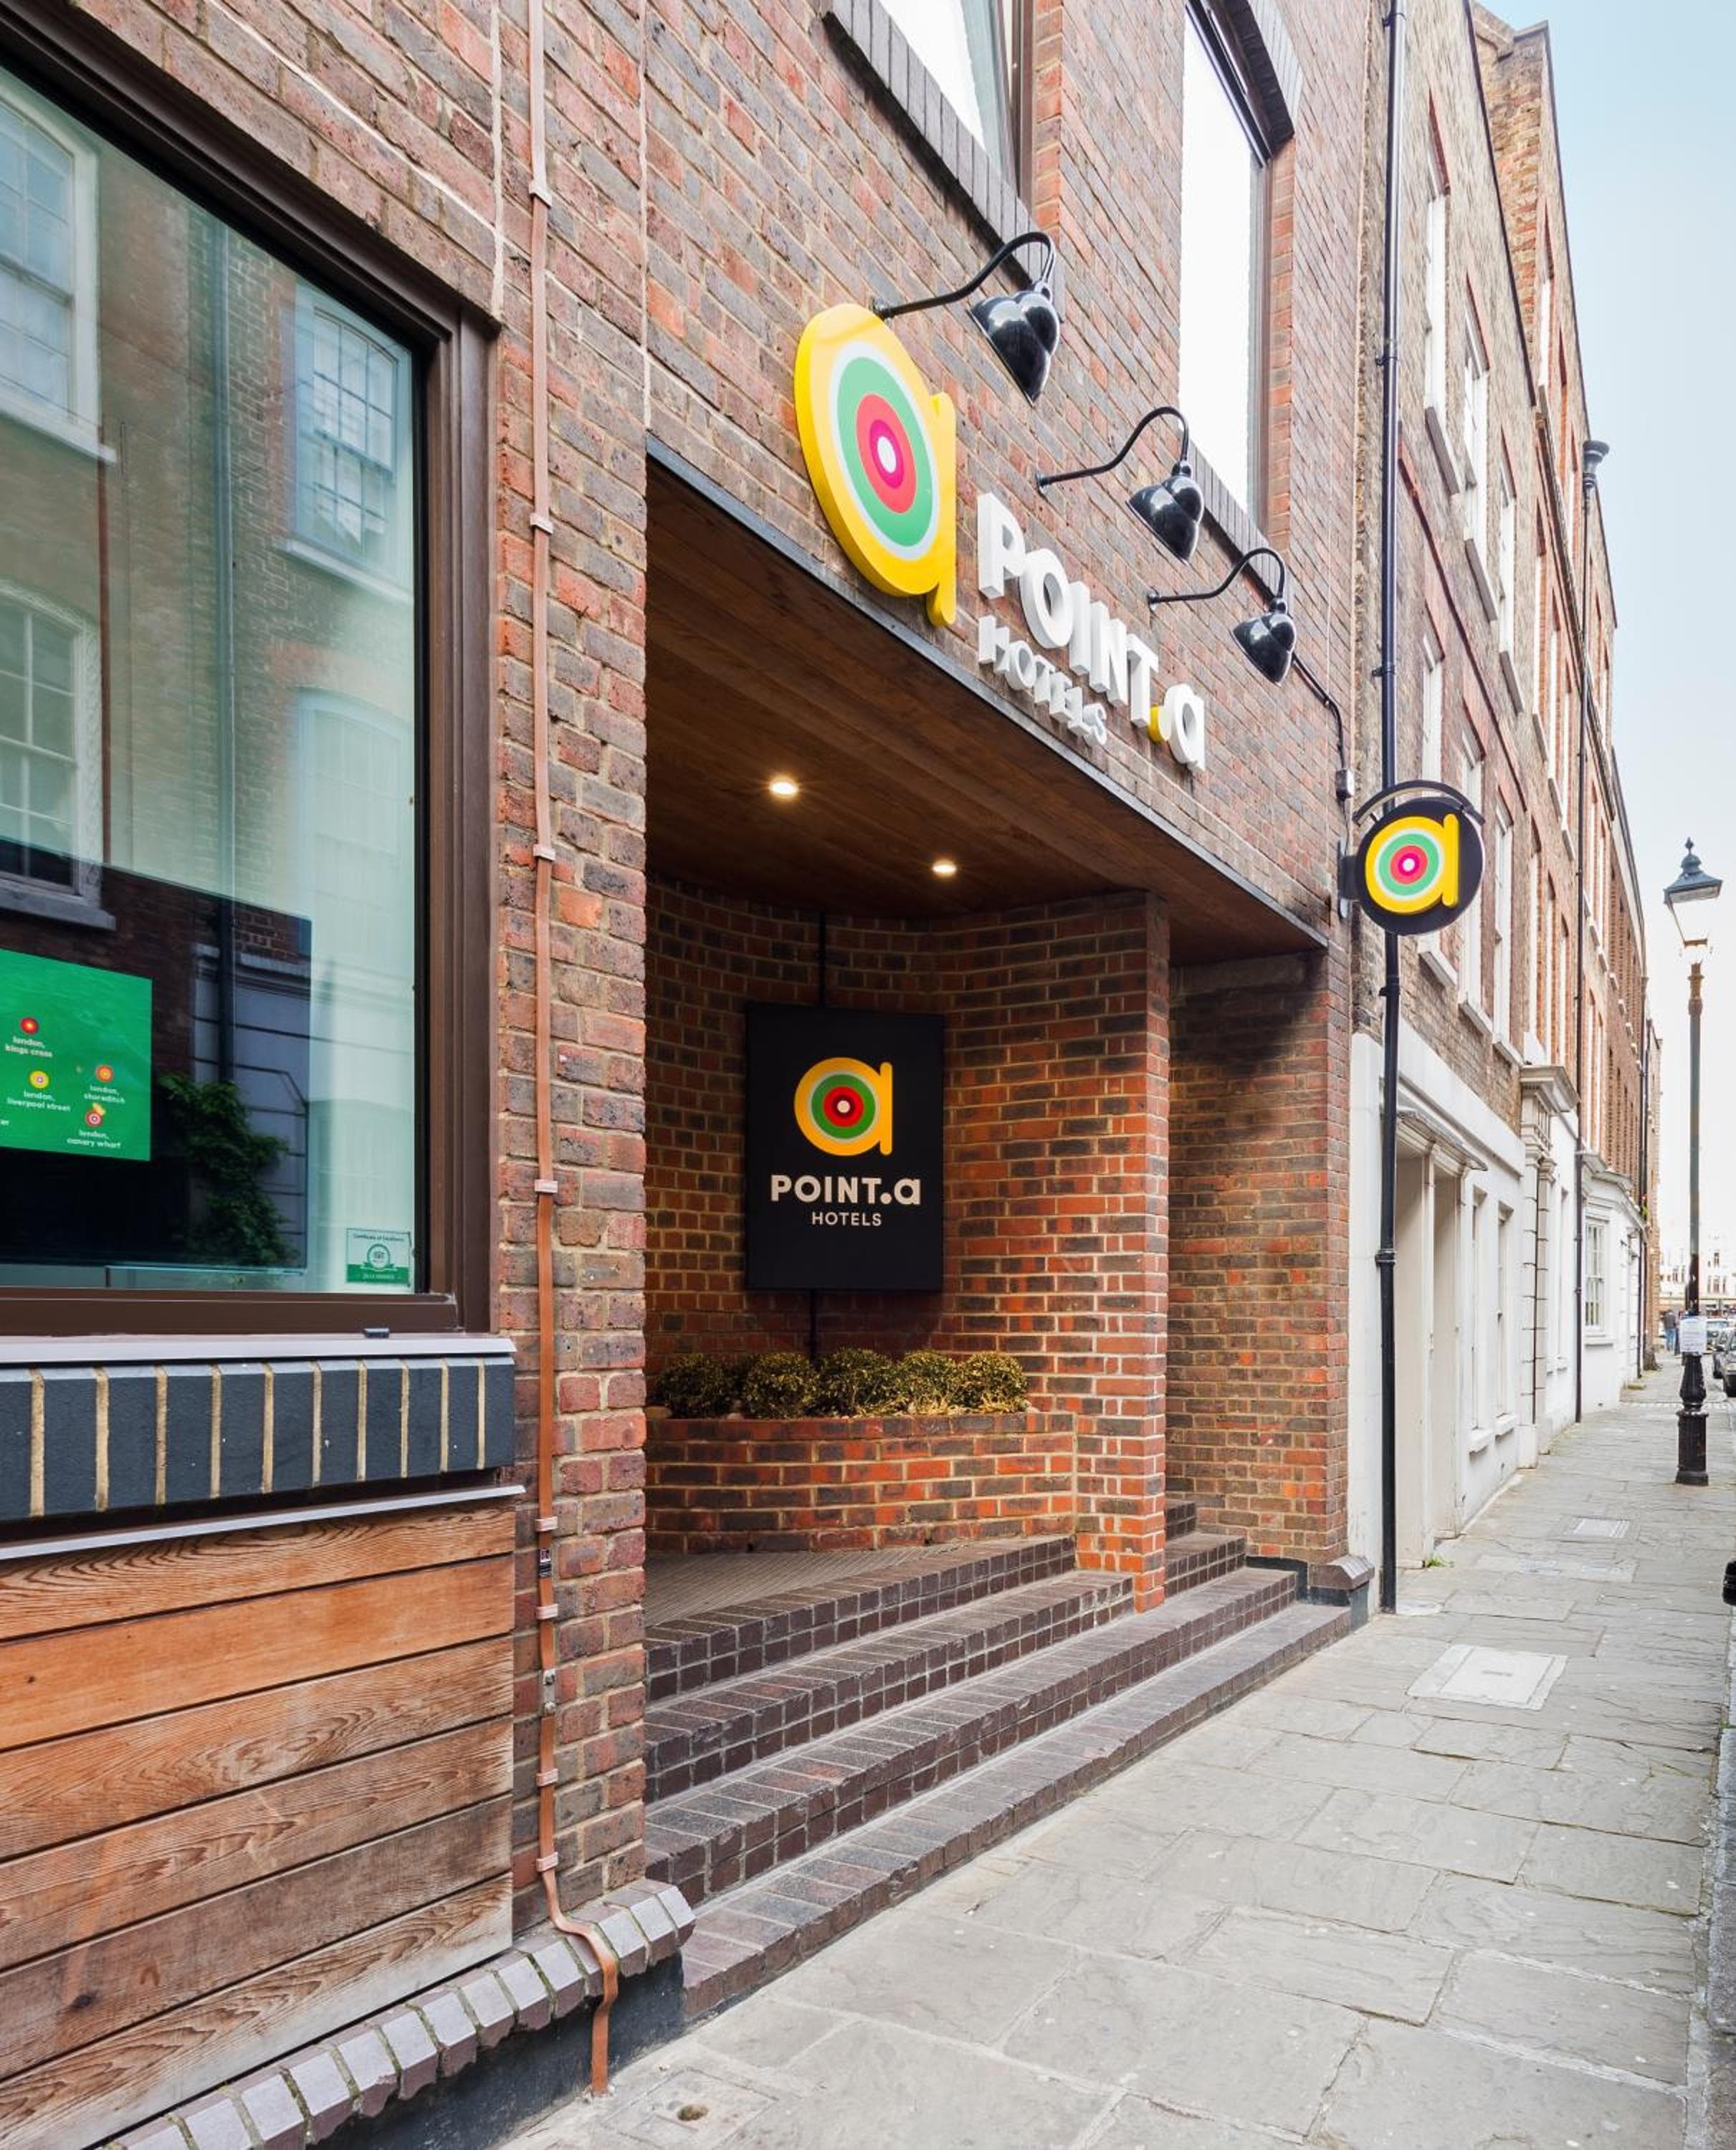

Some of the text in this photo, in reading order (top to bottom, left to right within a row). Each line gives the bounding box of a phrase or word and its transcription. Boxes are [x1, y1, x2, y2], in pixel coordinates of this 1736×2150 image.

[978, 614, 1107, 747] HOTELS
[771, 1174, 922, 1205] POINT.a
[811, 1211, 882, 1227] HOTELS
